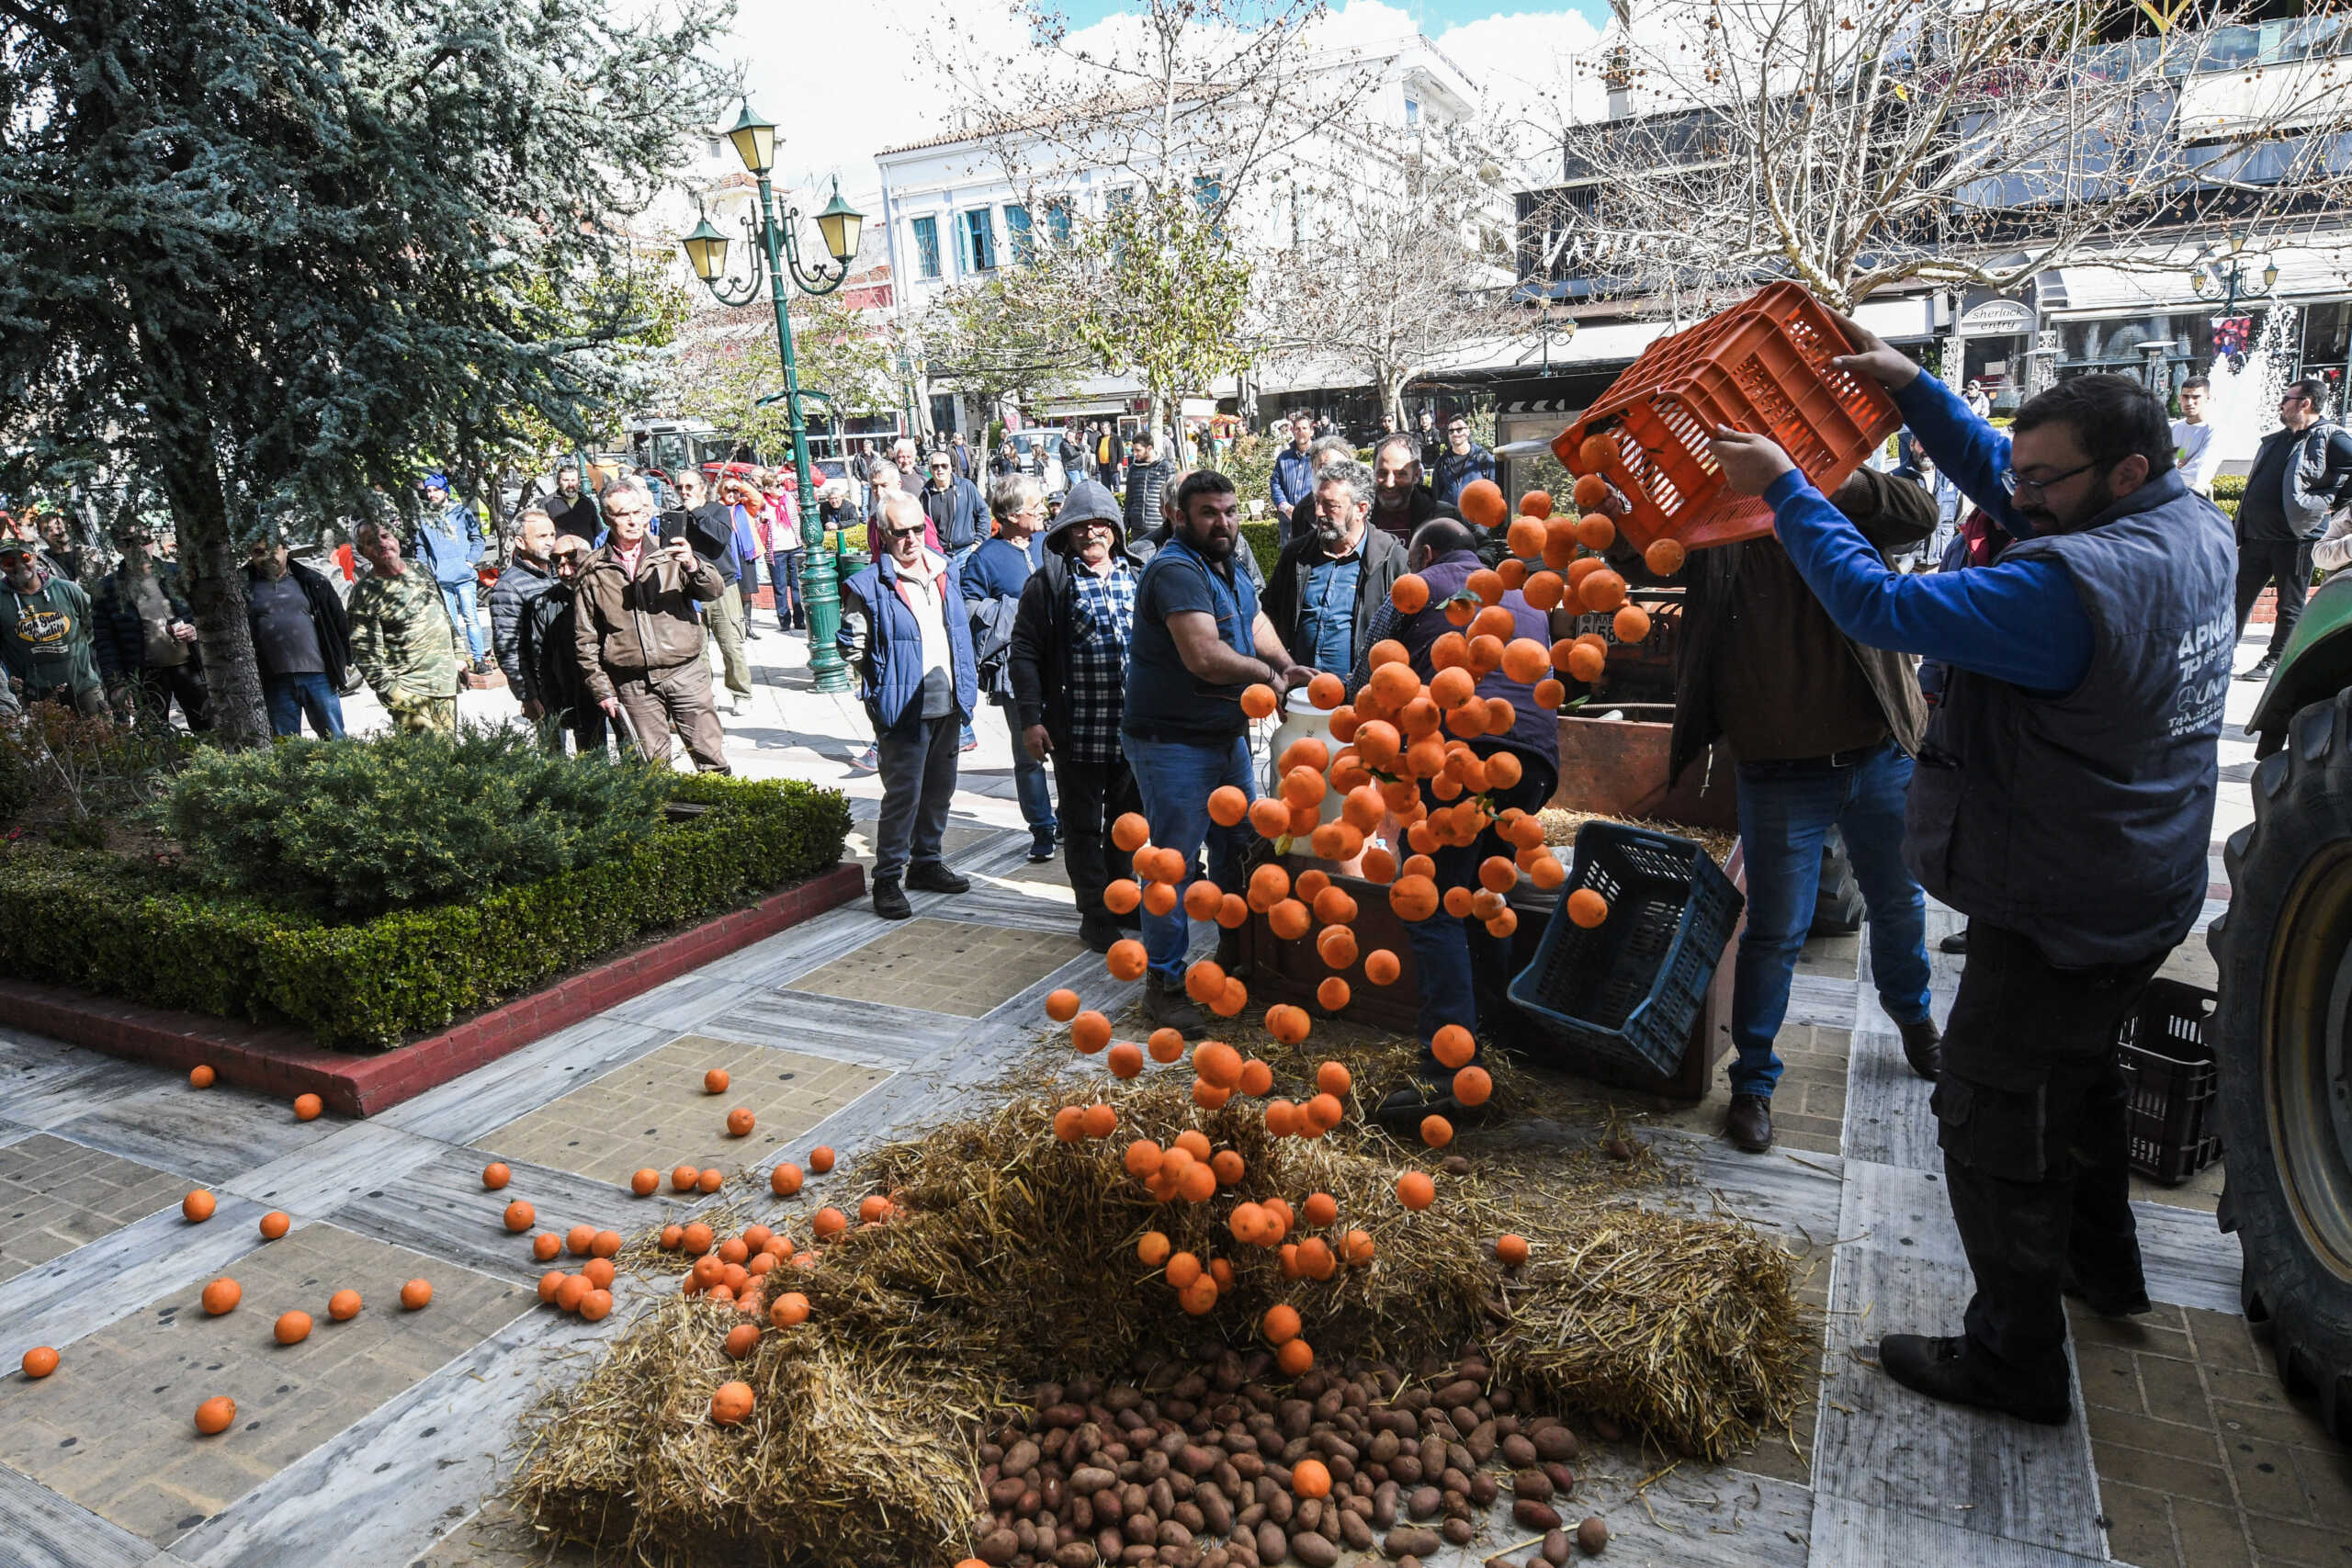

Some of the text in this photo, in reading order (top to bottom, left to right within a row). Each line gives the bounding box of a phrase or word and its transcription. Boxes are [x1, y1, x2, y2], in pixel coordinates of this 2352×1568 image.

[1973, 308, 2024, 320] sherlock
[1980, 321, 2015, 331] entry
[33, 623, 65, 641] Quality
